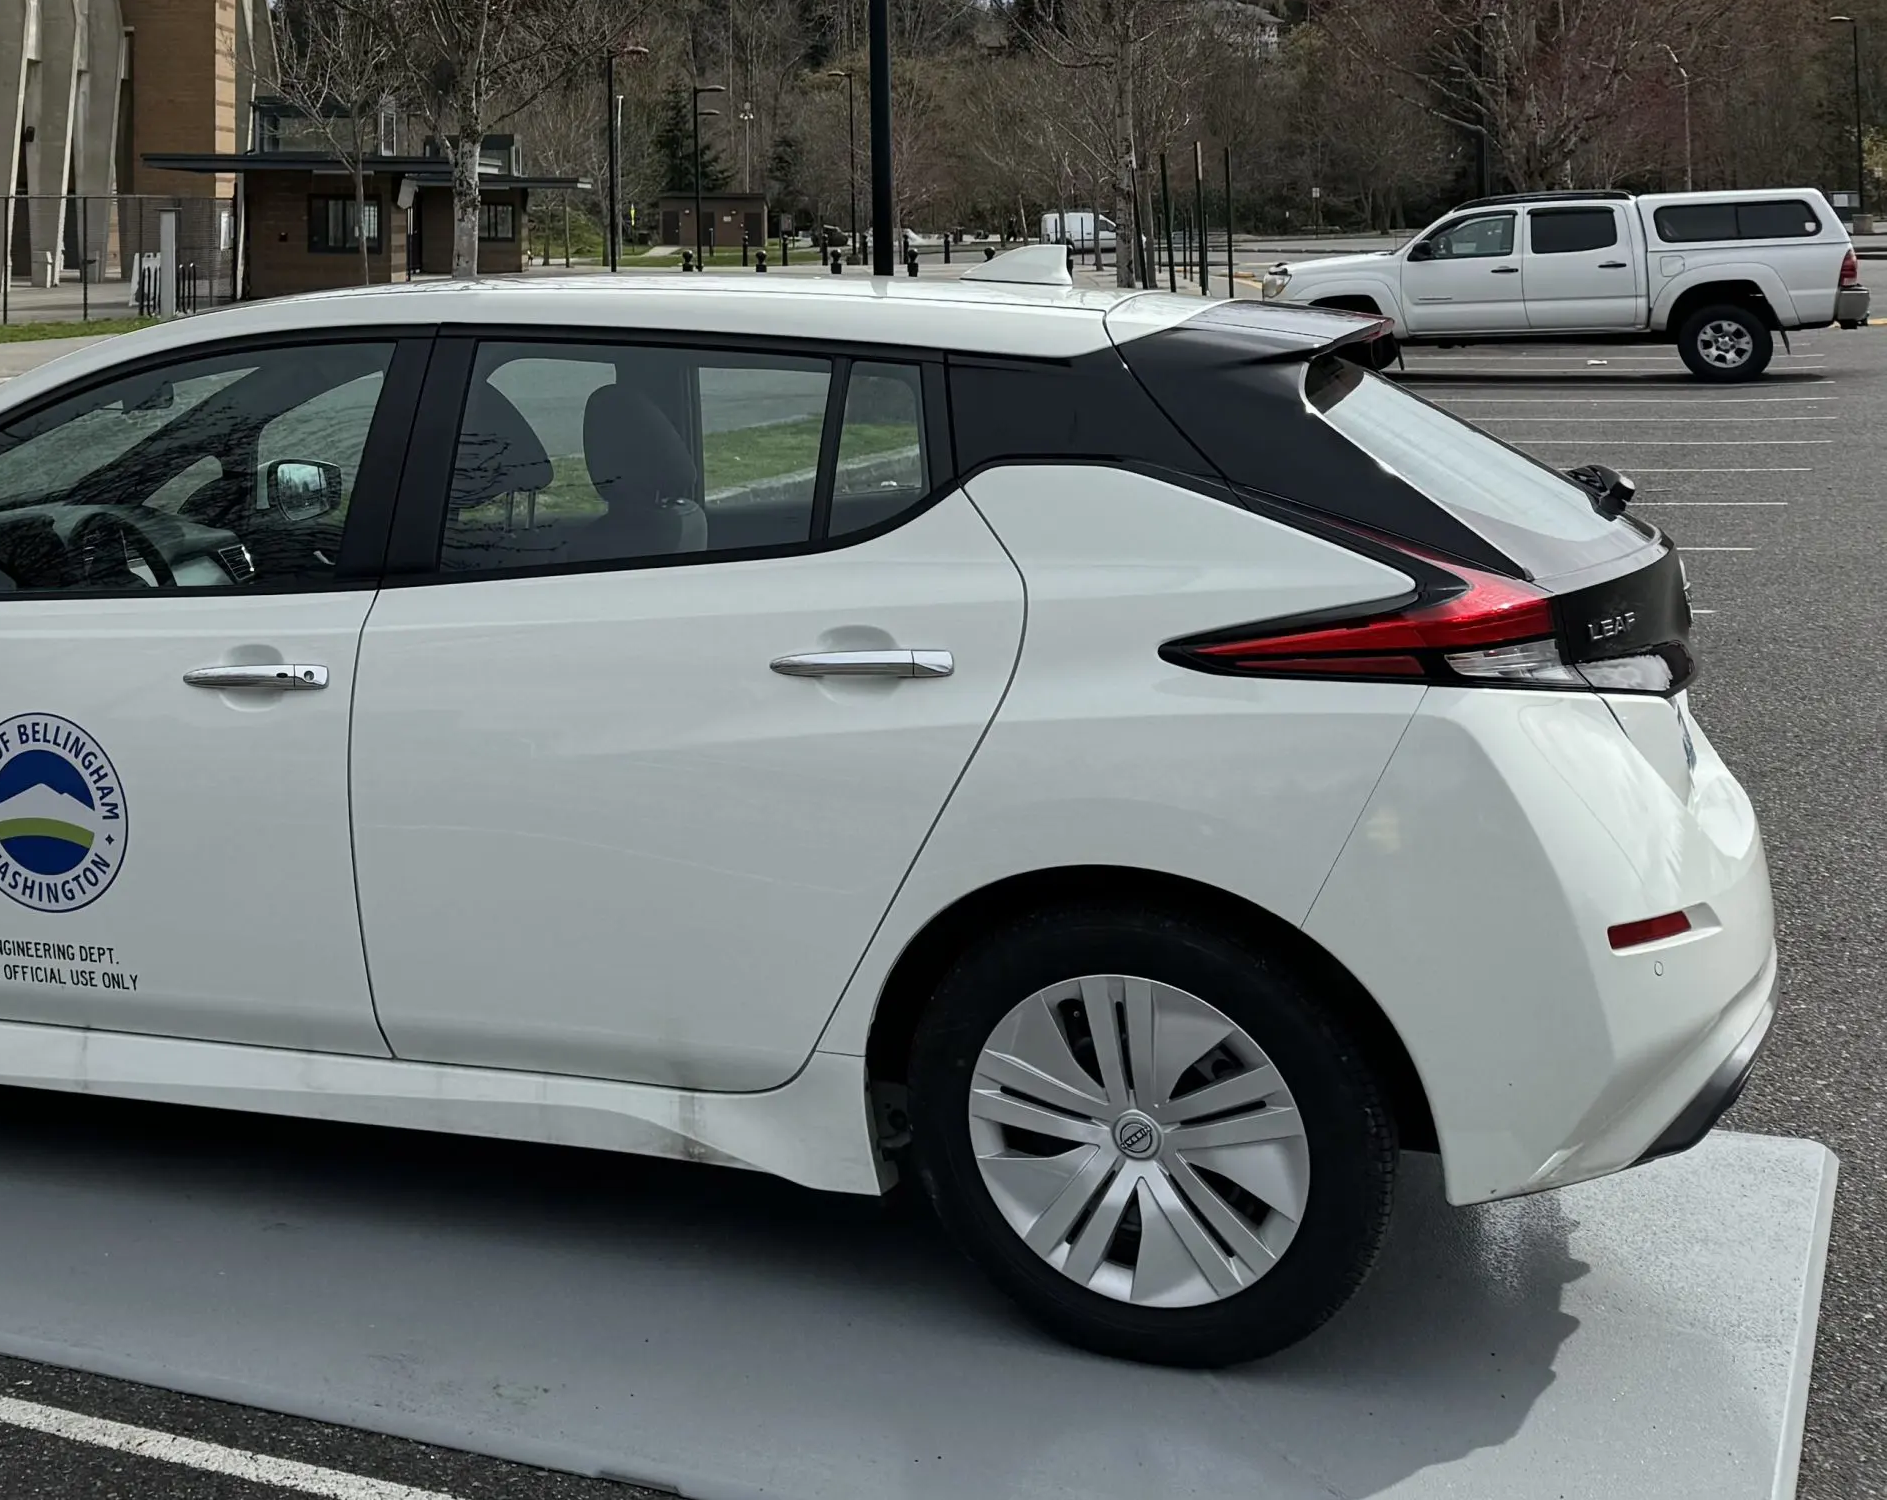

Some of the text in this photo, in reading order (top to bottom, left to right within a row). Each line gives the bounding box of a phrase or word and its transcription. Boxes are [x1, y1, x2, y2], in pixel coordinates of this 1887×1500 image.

[1587, 611, 1636, 641] LEAF
[17, 722, 120, 820] BELLINGHAM
[79, 945, 120, 965] DEPT.
[3, 964, 67, 985] OFFICIAL
[70, 969, 98, 988] USE
[102, 972, 138, 991] ONLY
